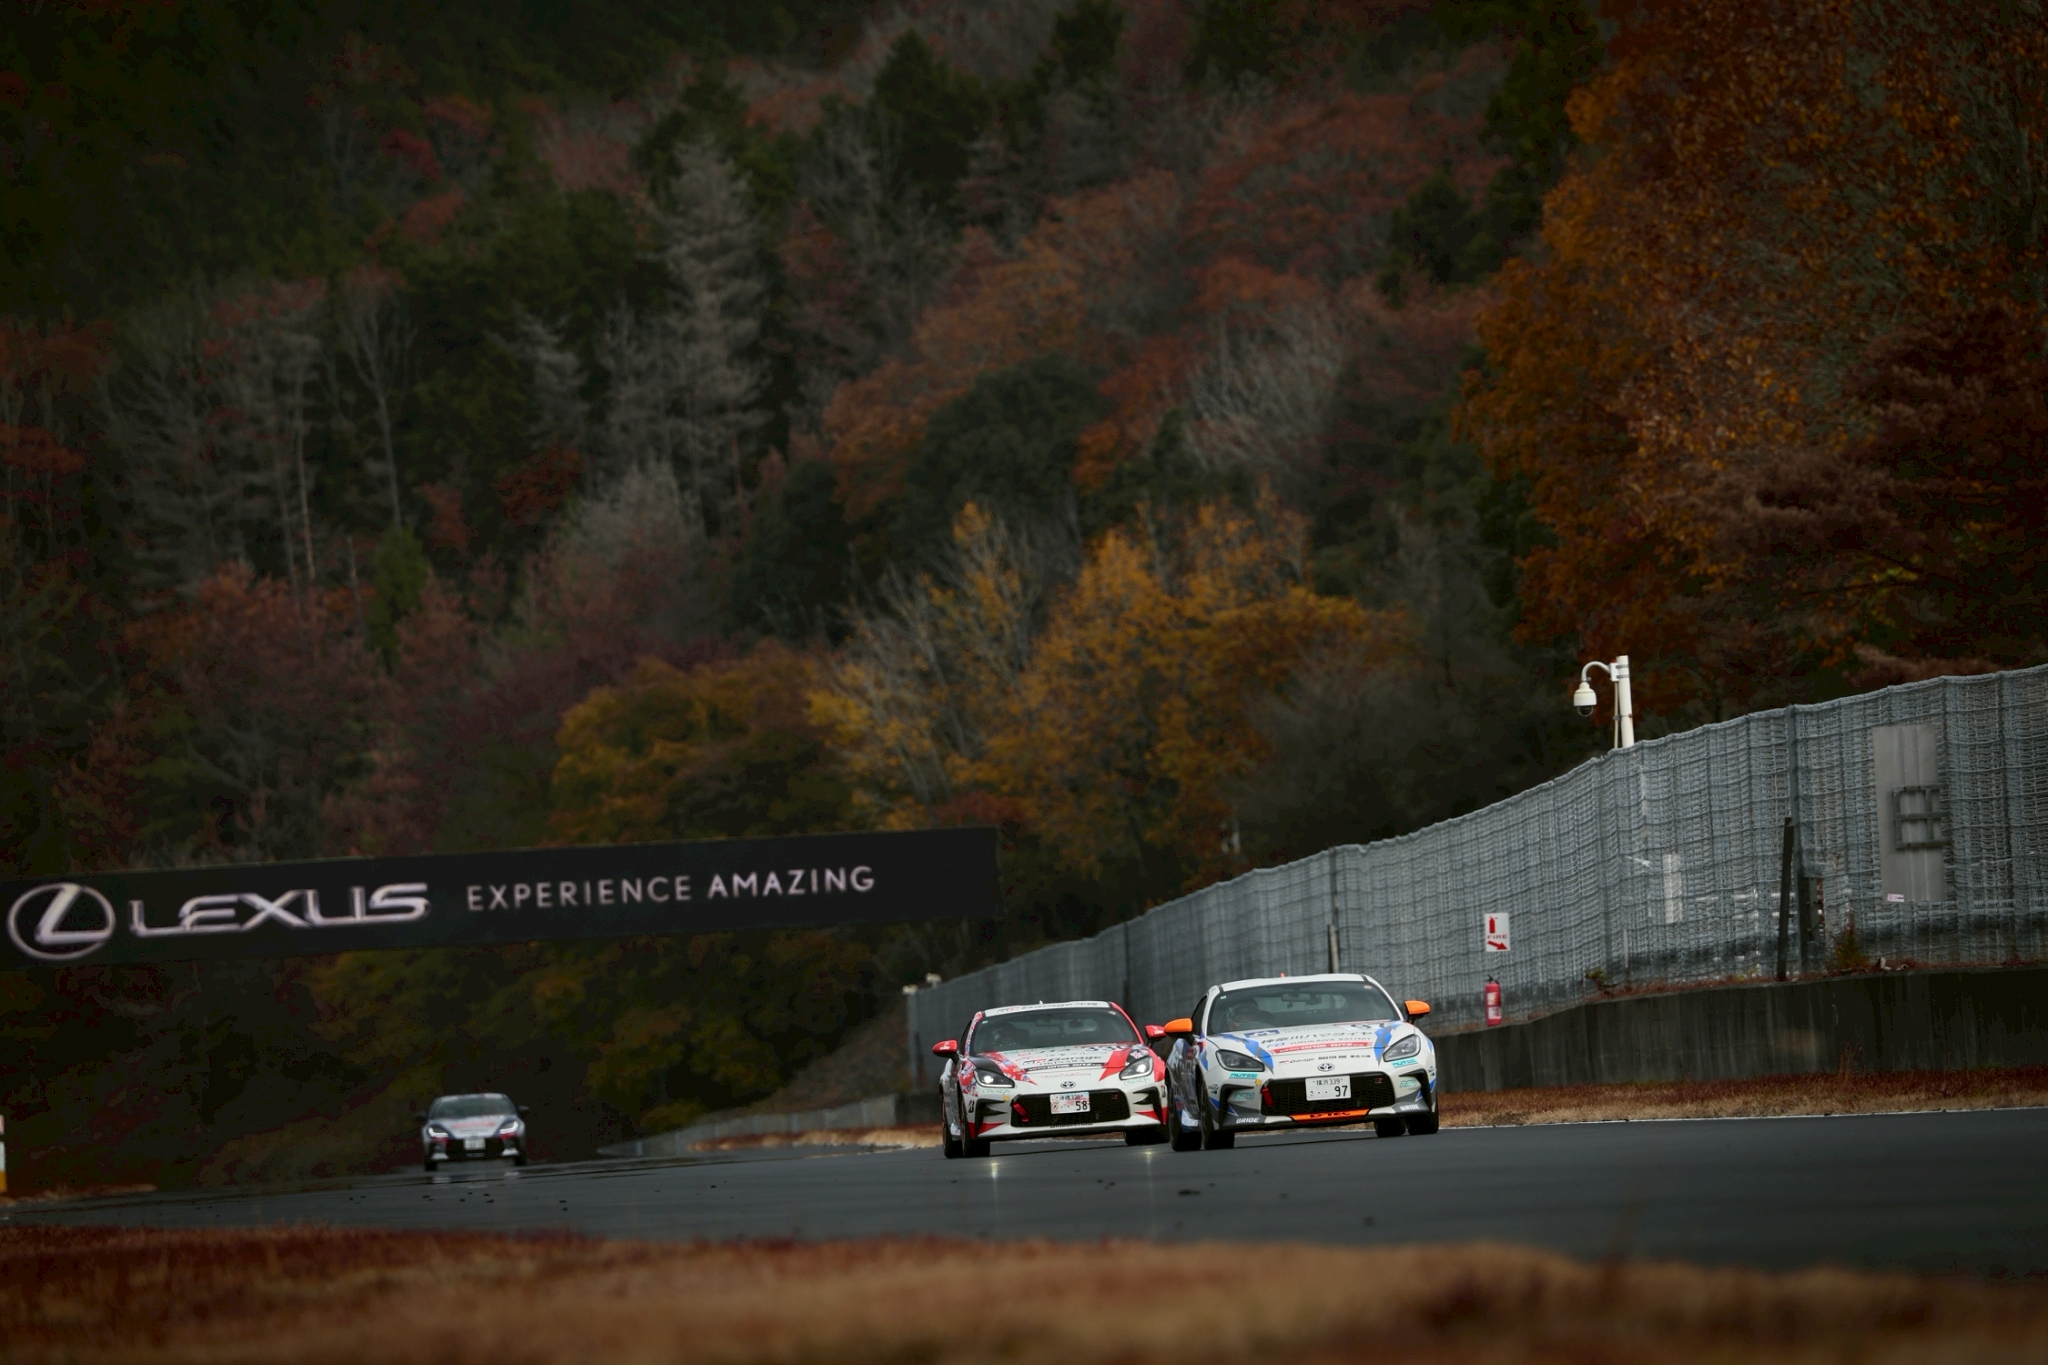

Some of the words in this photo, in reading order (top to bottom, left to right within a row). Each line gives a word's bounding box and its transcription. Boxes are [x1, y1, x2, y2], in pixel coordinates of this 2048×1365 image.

[131, 883, 429, 936] LEXUS
[468, 876, 689, 910] EXPERIENCE
[709, 866, 874, 897] AMAZING
[1392, 1059, 1417, 1067] NUTEC
[1334, 1085, 1348, 1097] 97
[1076, 1100, 1088, 1111] 58
